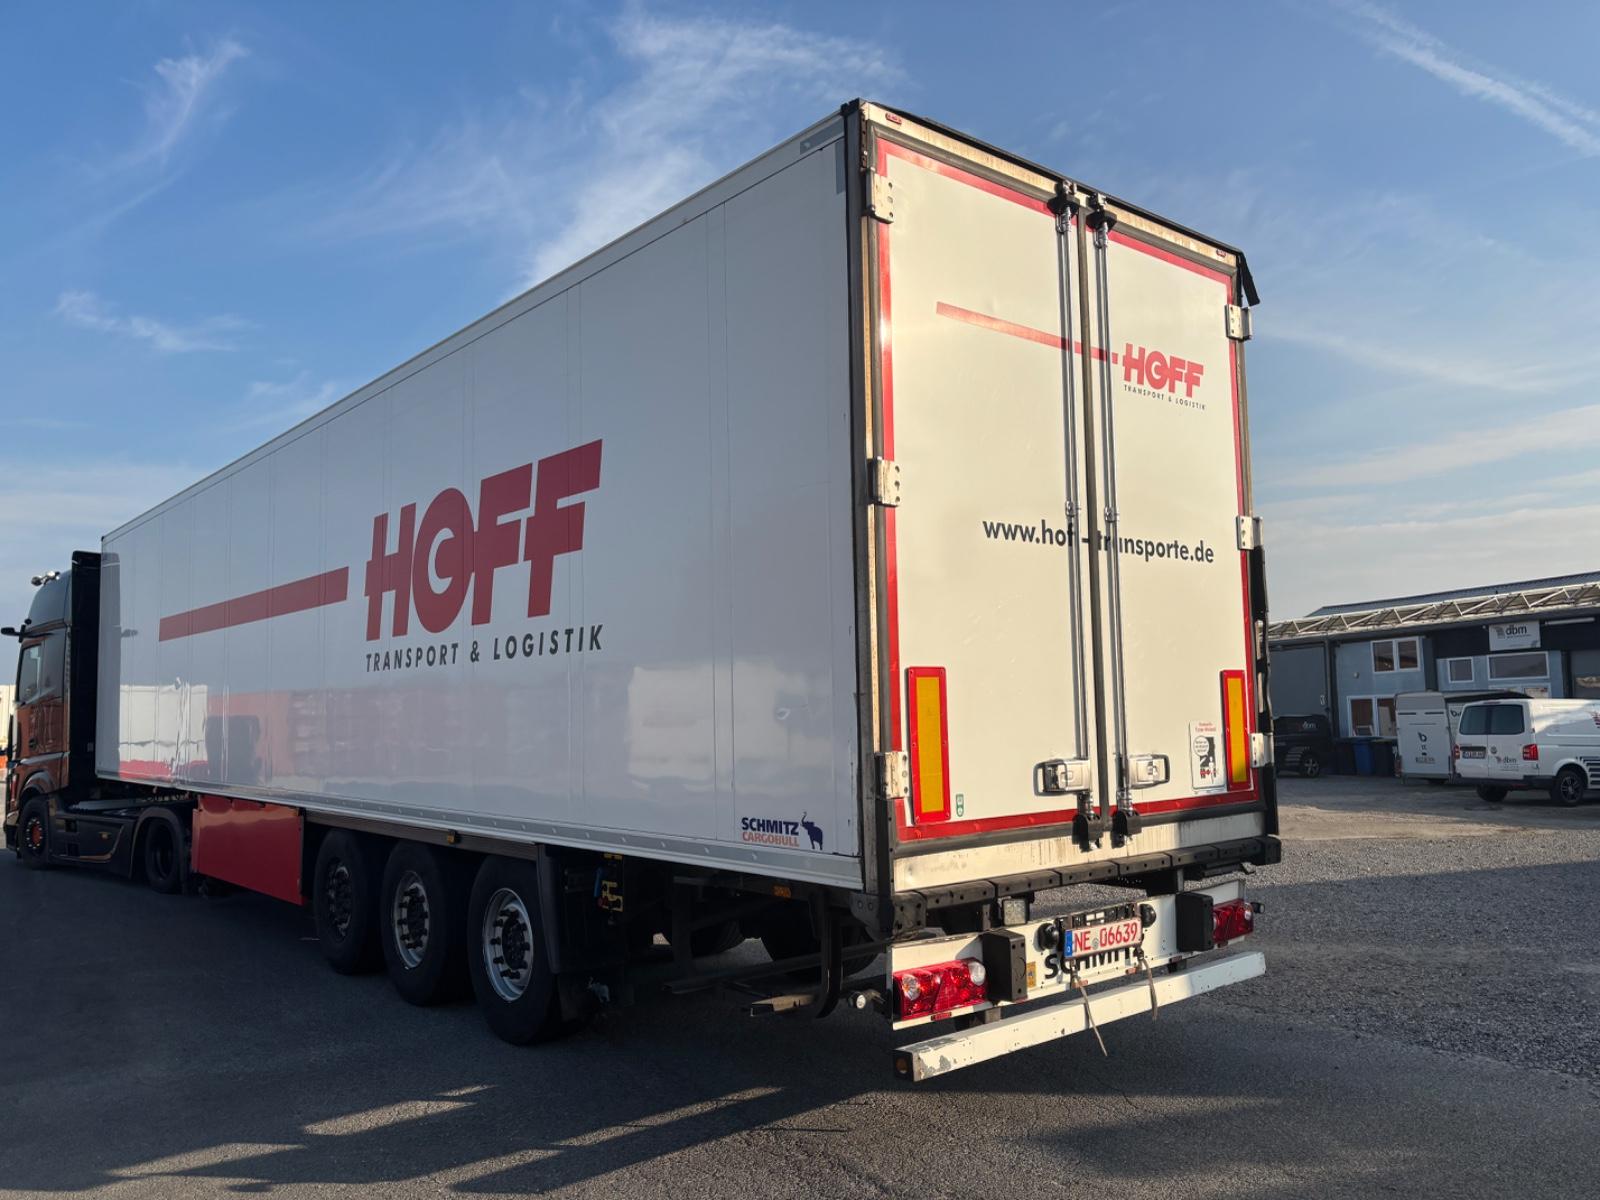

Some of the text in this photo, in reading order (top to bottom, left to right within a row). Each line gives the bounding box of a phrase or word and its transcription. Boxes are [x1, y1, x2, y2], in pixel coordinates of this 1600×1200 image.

[1122, 342, 1204, 398] HOFF
[1124, 384, 1165, 401] TRANSPORT
[1175, 398, 1206, 411] LOGISTIK
[364, 438, 603, 641] HOFF
[983, 519, 1214, 563] www.hof-trnsporte.de
[366, 624, 603, 673] TRANSPORT & LOGISTIK
[741, 817, 799, 836] SCHMITZ
[742, 831, 799, 847] CARGOBULL
[1074, 921, 1138, 952] NE 06639
